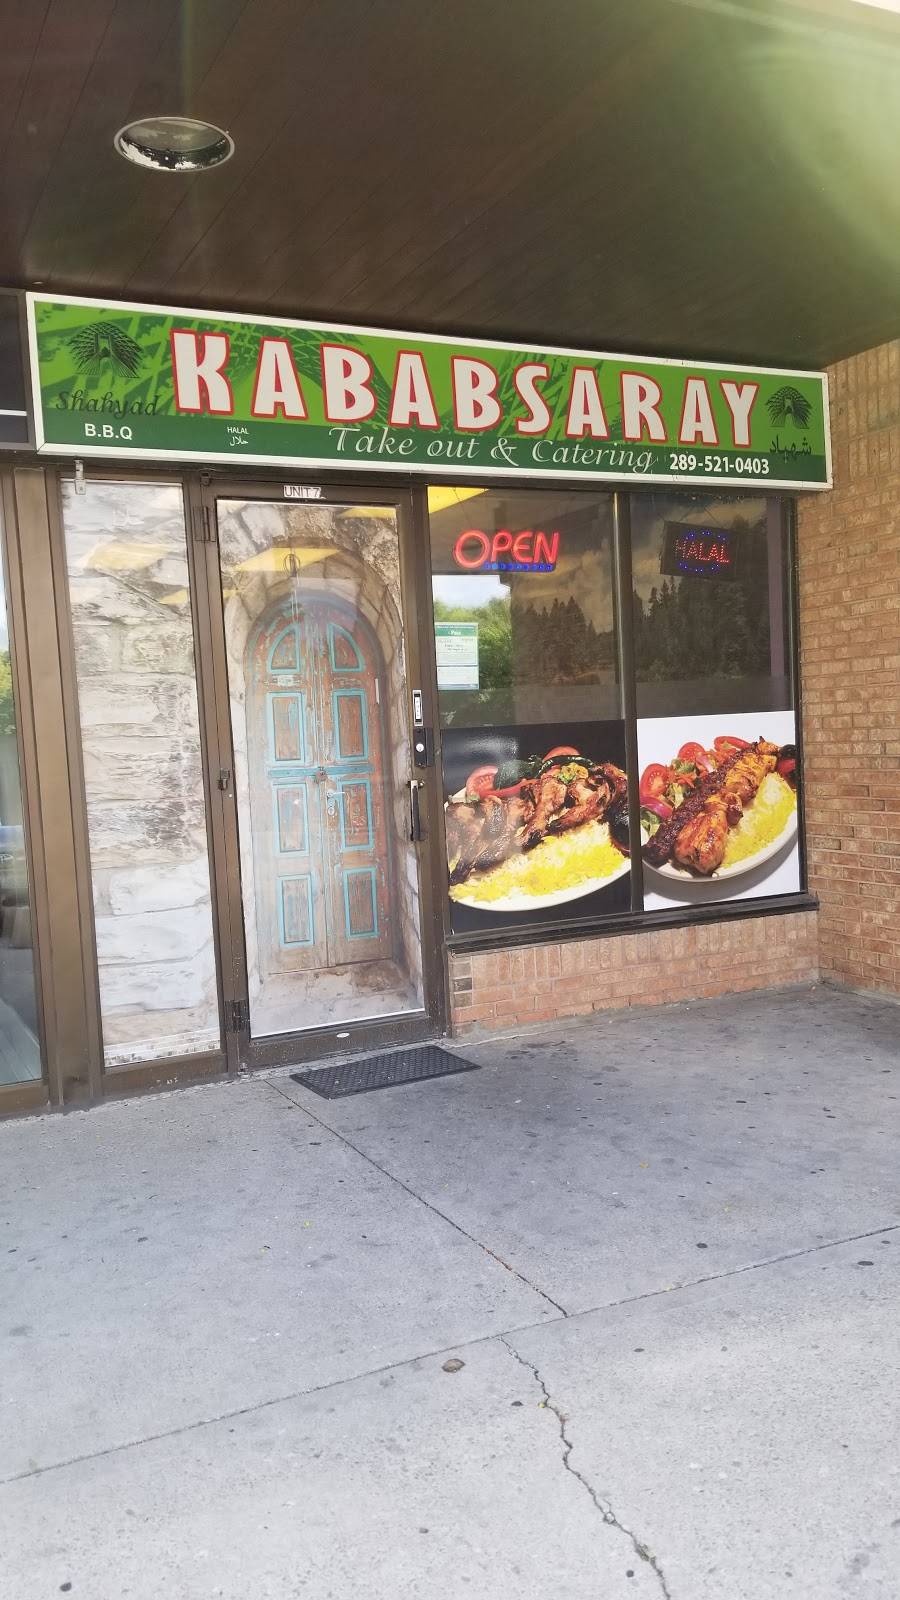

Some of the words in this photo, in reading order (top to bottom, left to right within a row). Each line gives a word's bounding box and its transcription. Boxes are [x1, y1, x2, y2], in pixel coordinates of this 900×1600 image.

[169, 327, 761, 448] KABABSARAY
[55, 389, 161, 420] Shahyad
[84, 423, 133, 441] B.B.Q
[227, 426, 249, 435] HALAL
[229, 435, 249, 447] حلال
[328, 426, 417, 456] Take
[426, 438, 480, 459] out
[490, 437, 520, 467] &
[532, 439, 656, 474] Catering
[669, 453, 770, 475] 289-521-0403
[453, 529, 560, 568] OPEN
[674, 539, 730, 563] HALAL
